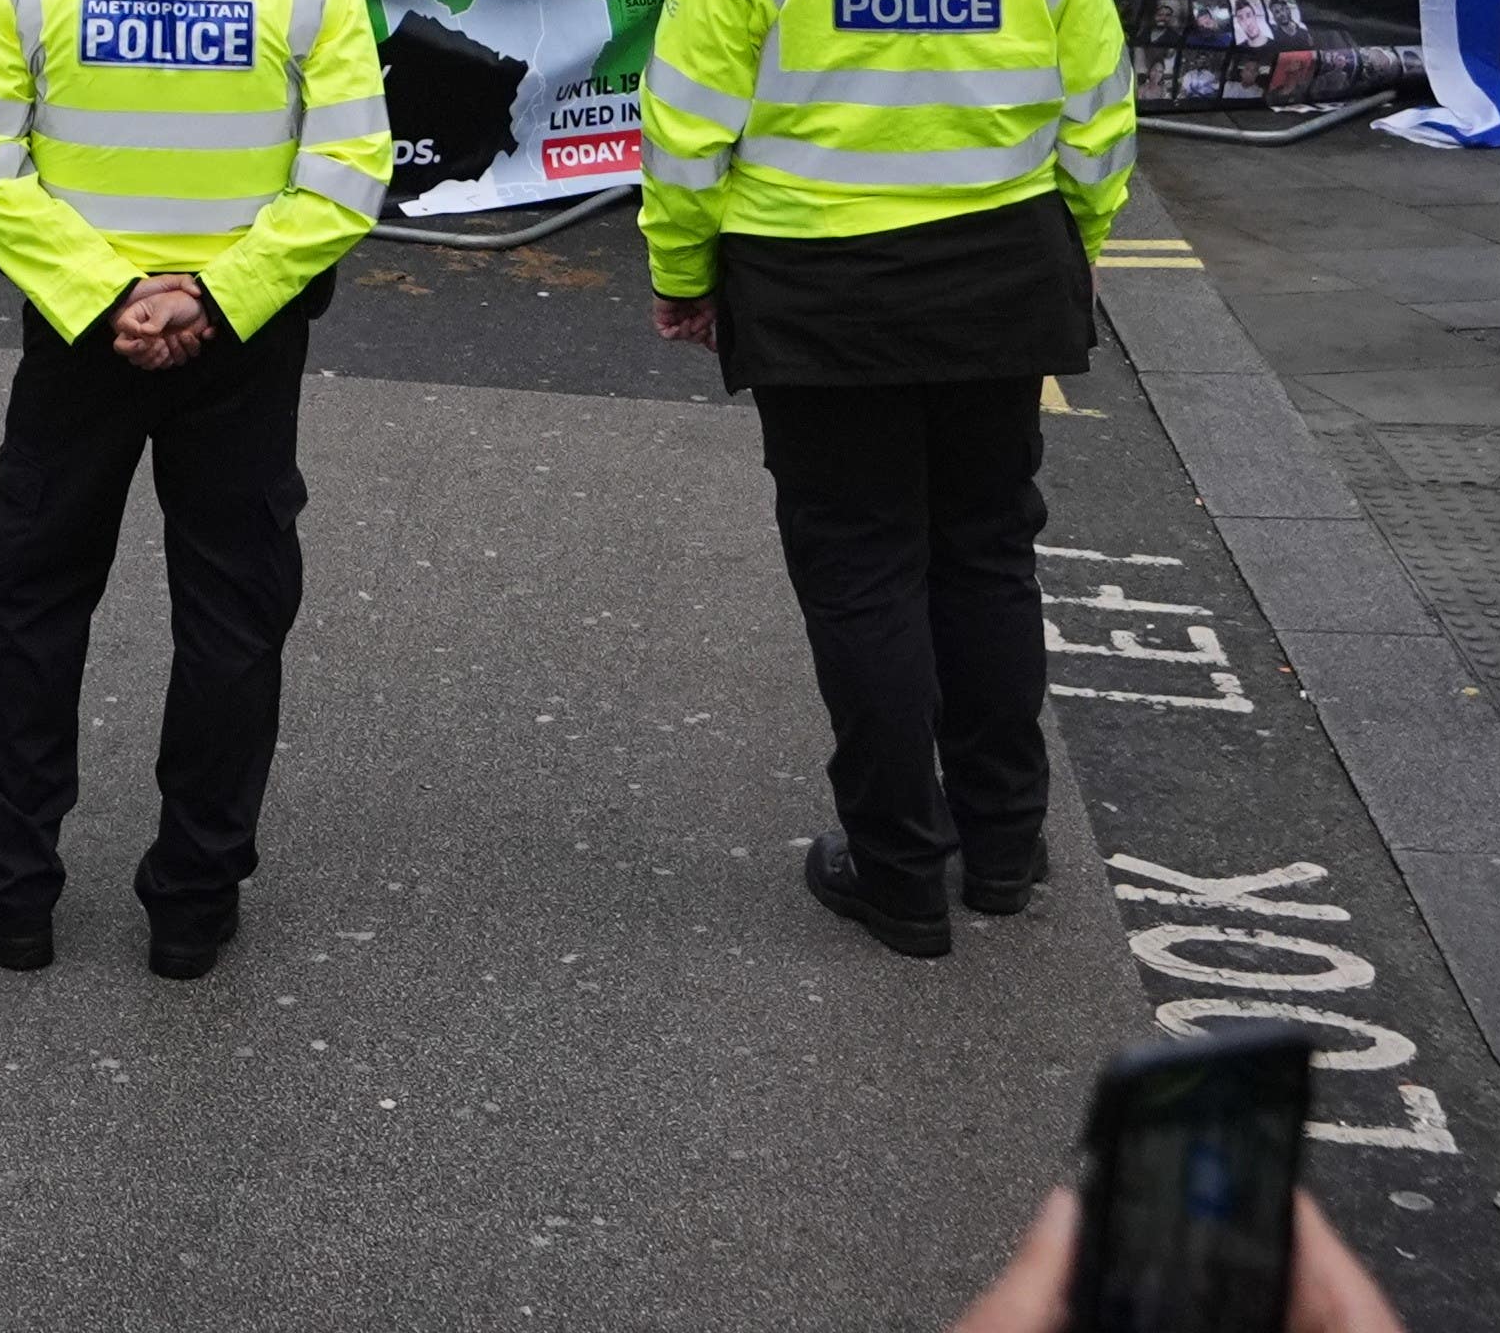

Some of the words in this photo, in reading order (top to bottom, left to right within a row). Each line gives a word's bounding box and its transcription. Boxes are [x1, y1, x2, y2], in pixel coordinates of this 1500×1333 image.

[87, 0, 250, 19] METROPOLITAN
[85, 17, 249, 63] POLICE
[555, 75, 615, 103] UNTIL
[549, 106, 614, 130] LIVED
[546, 139, 626, 168] TODAY
